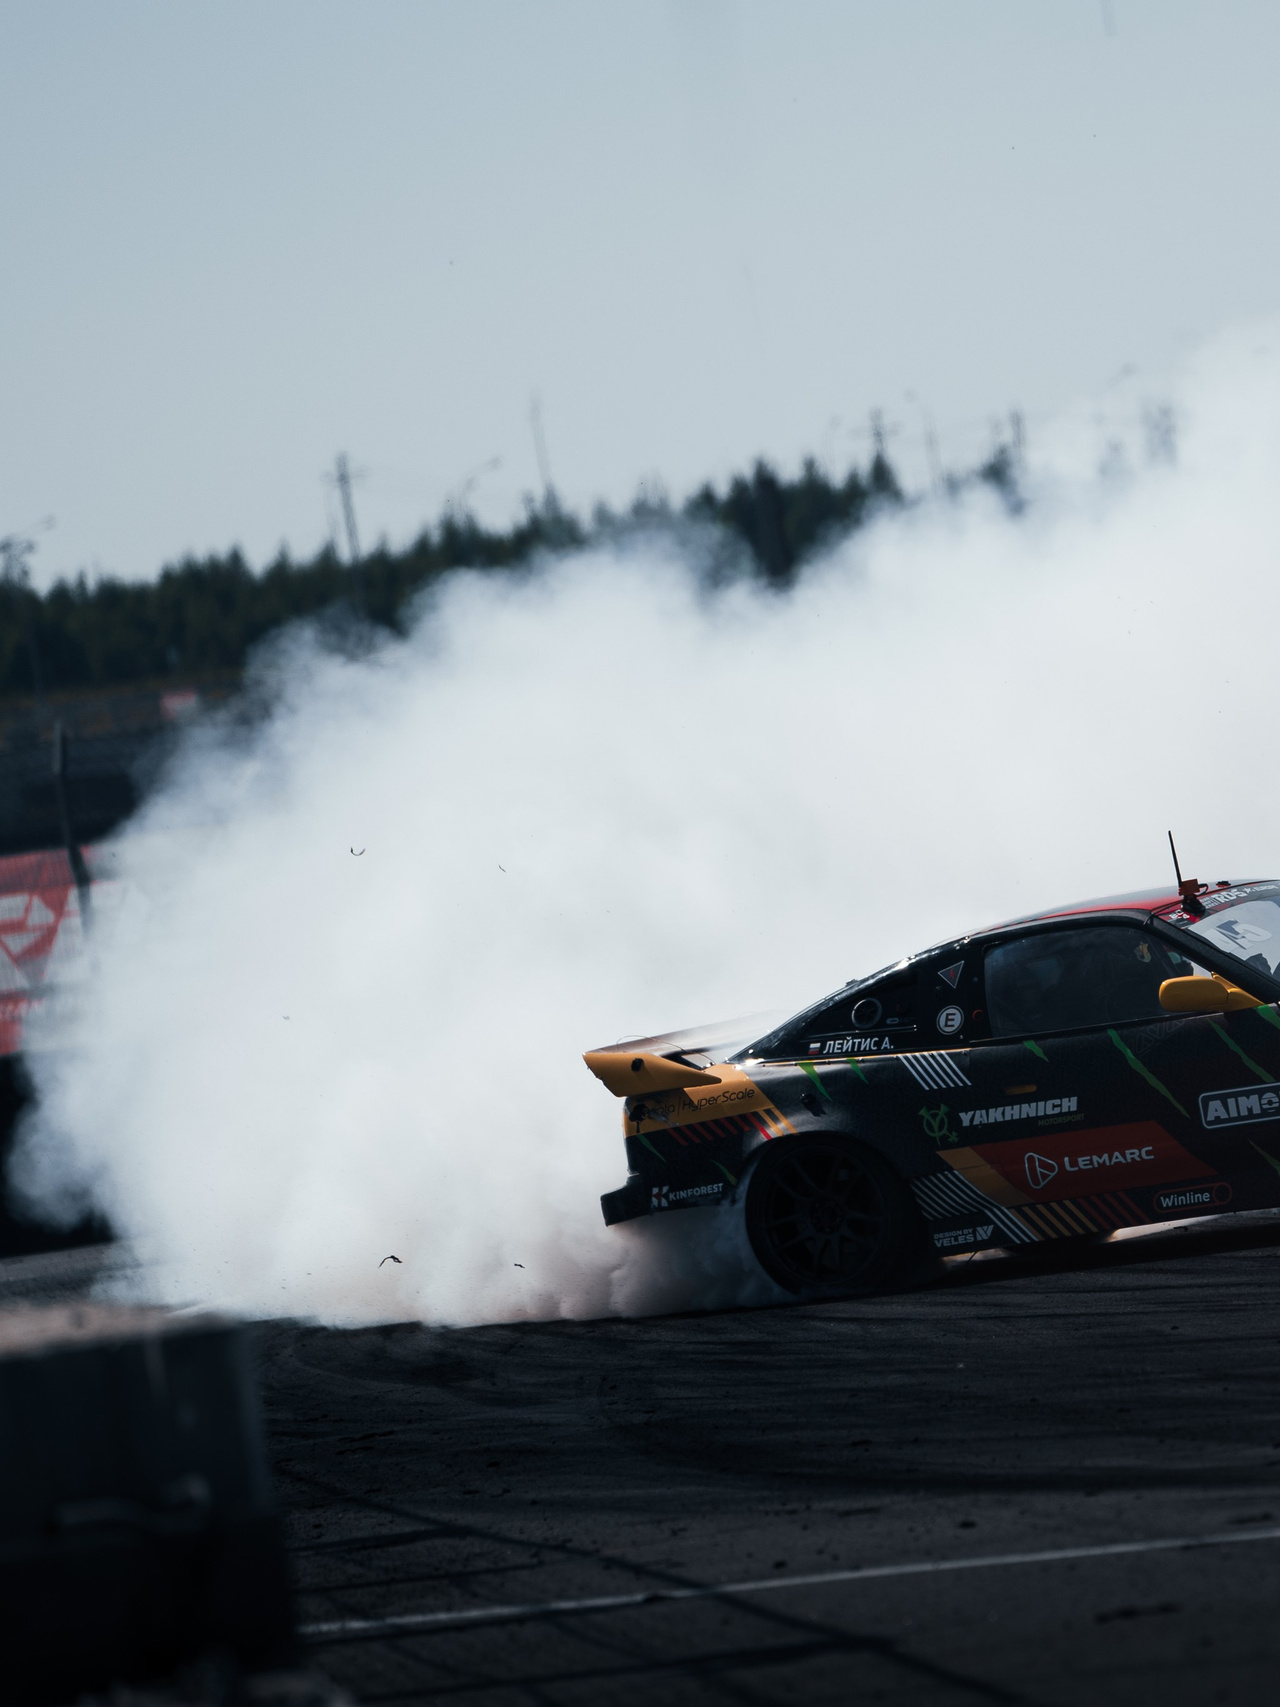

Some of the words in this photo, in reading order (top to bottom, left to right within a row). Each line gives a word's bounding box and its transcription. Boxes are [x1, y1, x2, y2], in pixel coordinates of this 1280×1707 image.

[823, 1036, 879, 1054] ЛЕЙТИС
[881, 1037, 894, 1050] А.
[682, 1088, 755, 1111] HyperScale
[958, 1096, 1078, 1127] YAKHNICH
[1038, 1113, 1085, 1126] MOTORSPORT
[1064, 1146, 1155, 1172] LEMARC
[669, 1183, 724, 1201] KINFOREST
[1160, 1191, 1211, 1208] Winline
[933, 1230, 962, 1240] DESIGN
[934, 1234, 975, 1248] VELES
